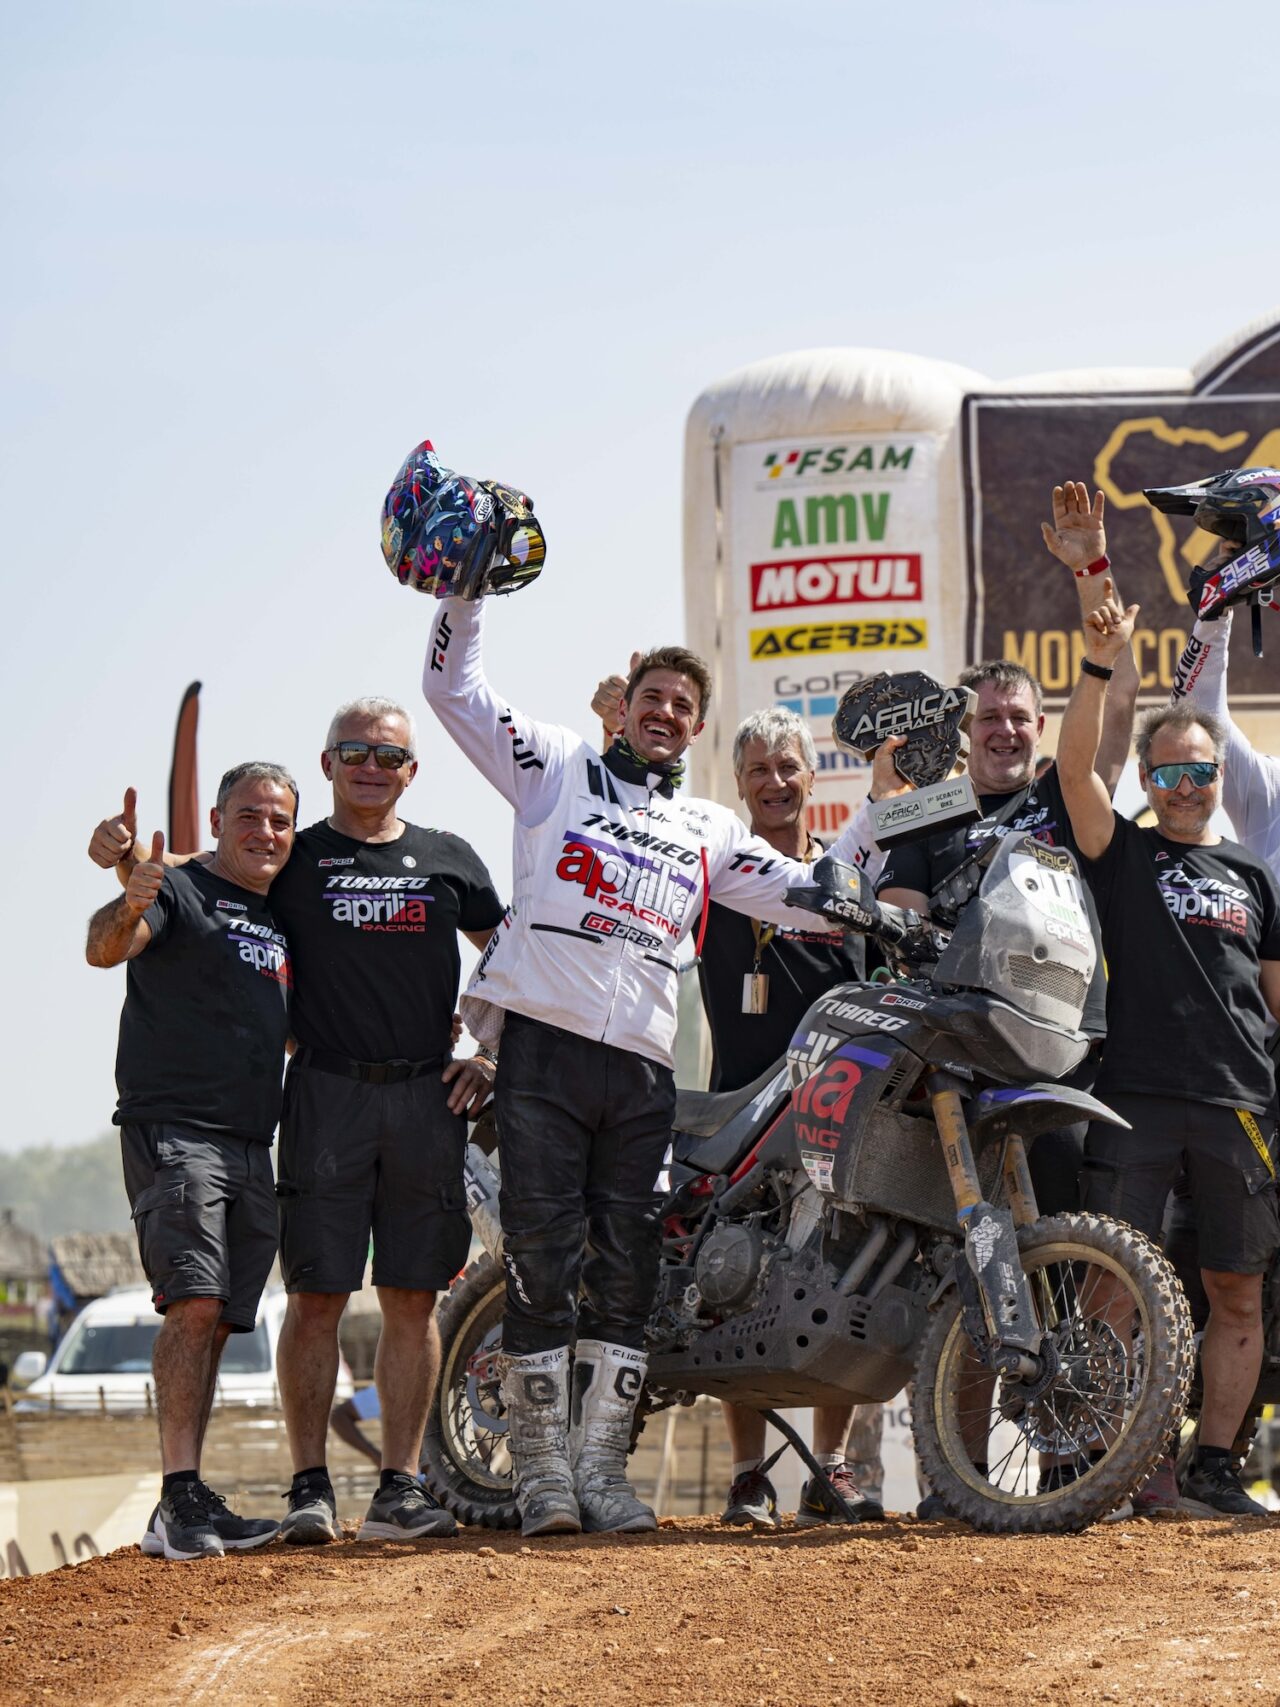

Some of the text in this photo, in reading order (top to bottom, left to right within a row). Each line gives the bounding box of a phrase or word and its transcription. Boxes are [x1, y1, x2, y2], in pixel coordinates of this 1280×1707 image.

[795, 446, 914, 475] FSAM
[756, 559, 917, 606] MOTUL
[754, 623, 924, 657] ACERBIS
[1186, 644, 1212, 692] RACING
[851, 689, 961, 740] AFRICA
[883, 804, 920, 822] AFRICA
[326, 875, 430, 890] TUAREG
[556, 841, 690, 925] aprilia
[332, 893, 426, 927] aprilia
[1163, 891, 1248, 928] aprilia
[1187, 916, 1247, 937] RACING
[362, 924, 426, 932] RACING
[817, 1000, 910, 1031] TUAREG
